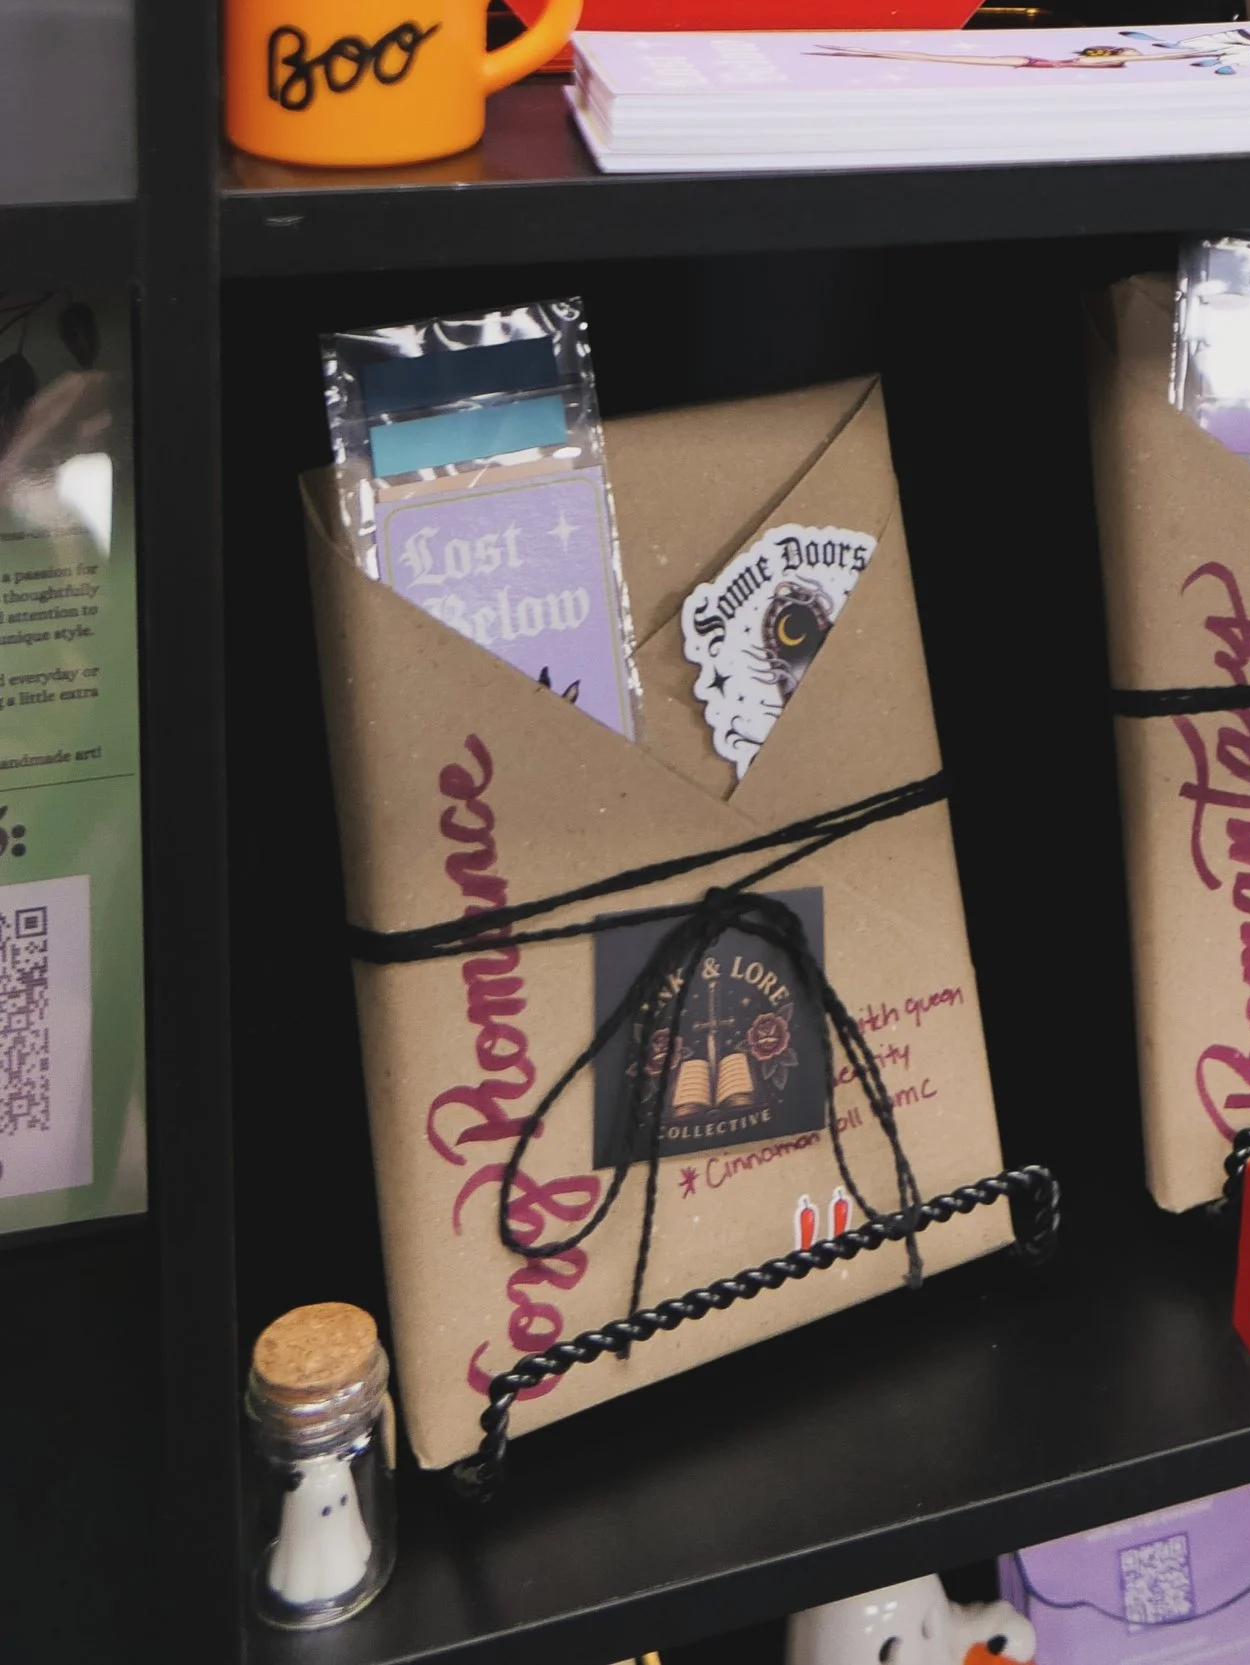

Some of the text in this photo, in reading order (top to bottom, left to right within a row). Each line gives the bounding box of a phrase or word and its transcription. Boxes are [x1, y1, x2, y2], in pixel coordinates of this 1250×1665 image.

[399, 520, 524, 588] Lost
[693, 535, 869, 660] Some Doors
[0, 748, 72, 770] andmade
[426, 734, 543, 1166] Romnce
[702, 957, 720, 979] &
[730, 956, 791, 1006] LORE
[857, 986, 964, 1036] itch queen
[659, 1108, 772, 1140] OLLECTIVE
[836, 1107, 862, 1134] oll
